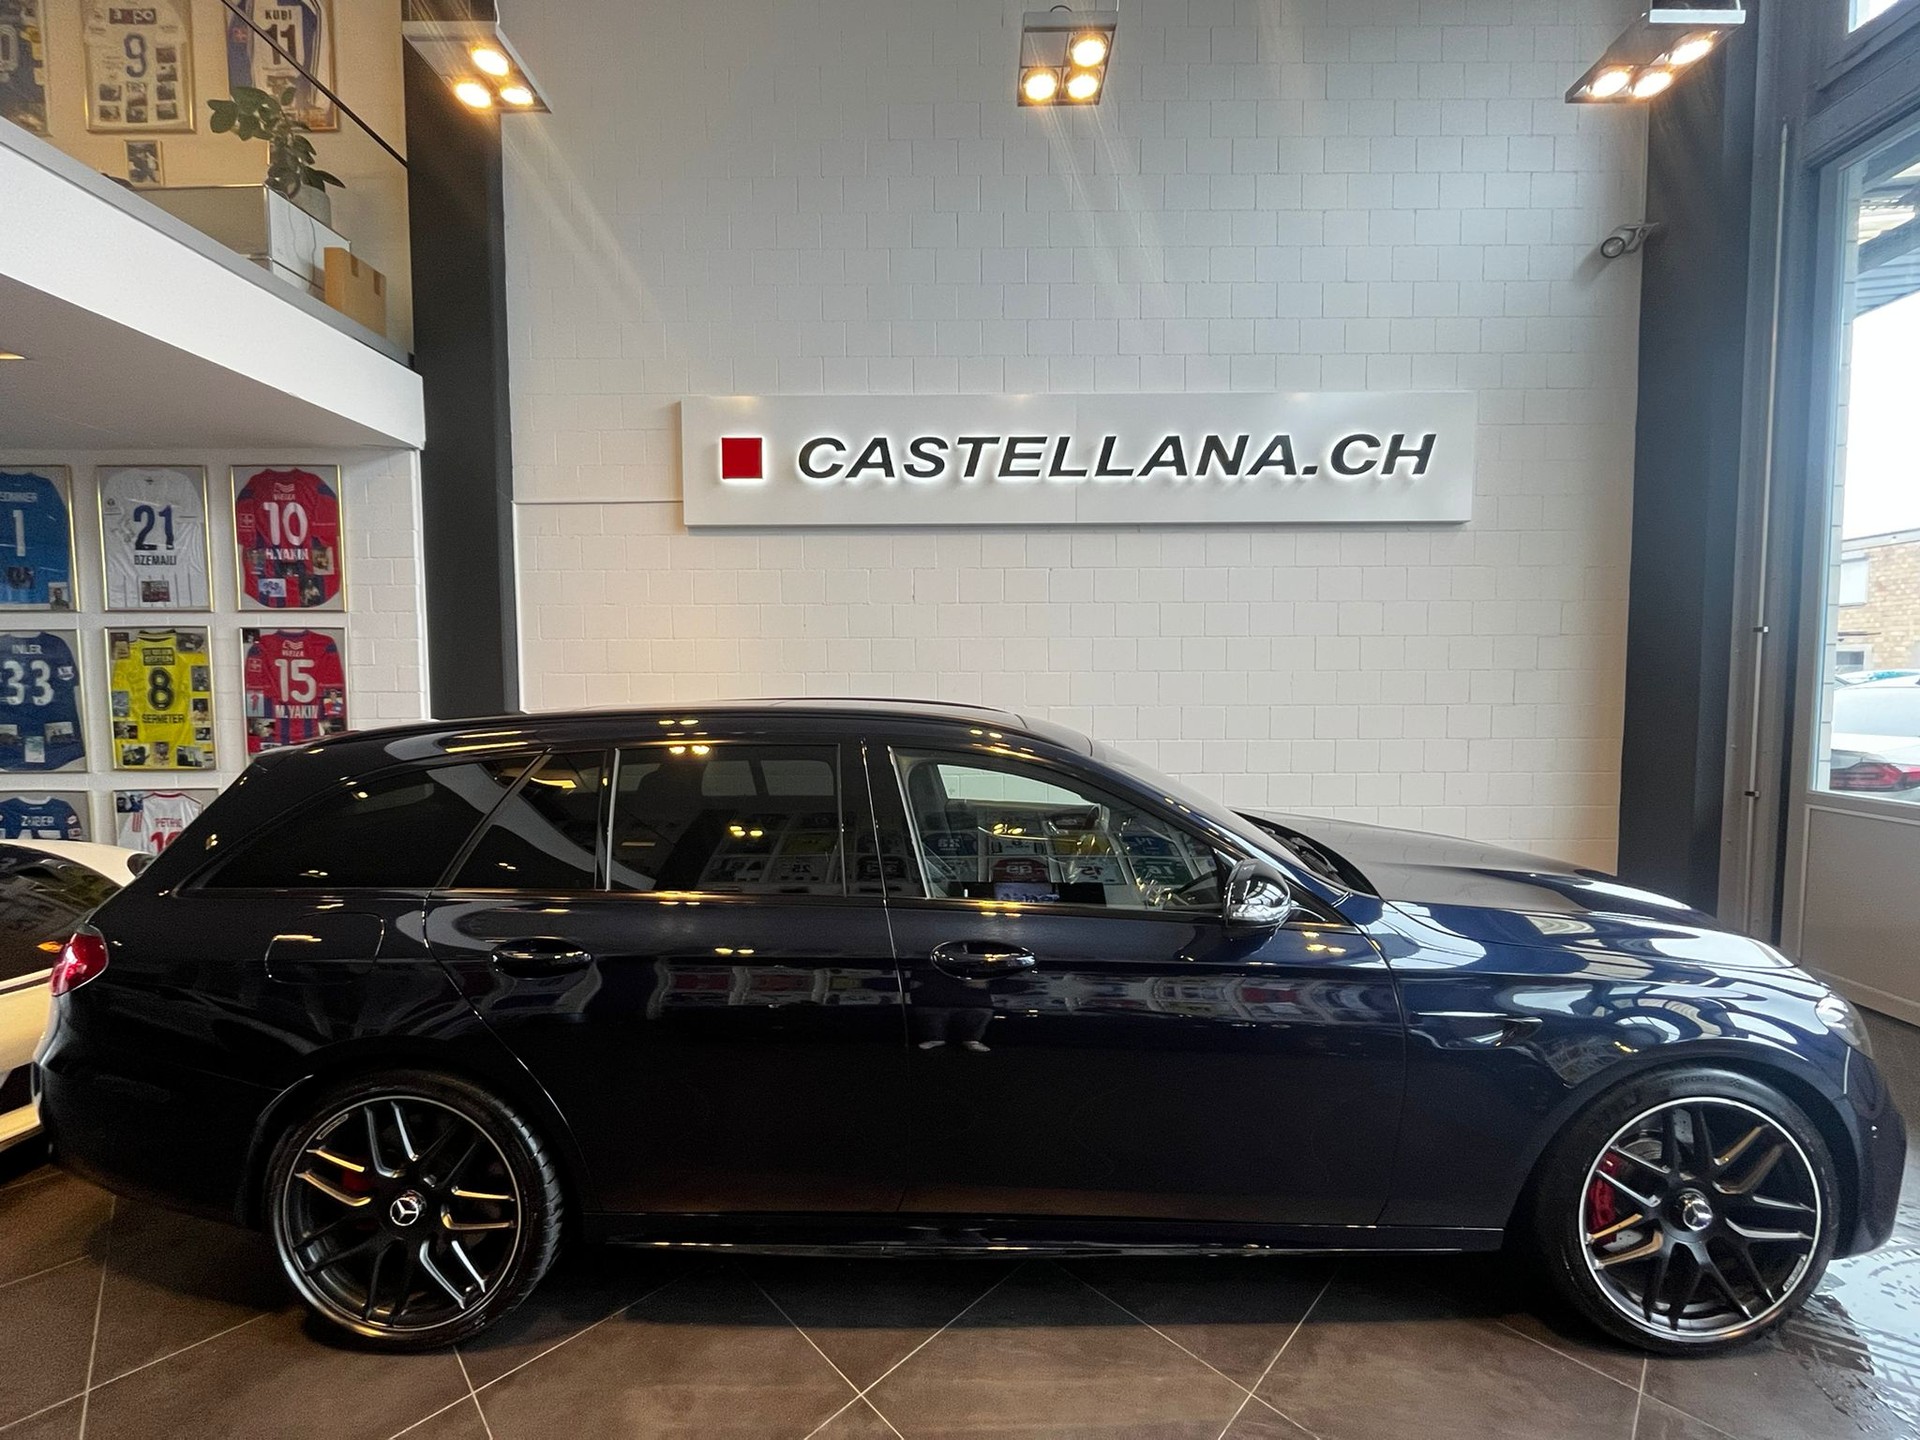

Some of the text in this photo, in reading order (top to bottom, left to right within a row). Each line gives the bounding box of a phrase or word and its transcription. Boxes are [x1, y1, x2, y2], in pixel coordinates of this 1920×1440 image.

[265, 9, 292, 20] KUBI
[124, 32, 147, 78] 9
[264, 24, 296, 65] 11
[798, 433, 1437, 479] CASTELLANA.CH
[133, 504, 174, 550] 21
[263, 501, 309, 546] 10
[134, 554, 176, 566] DZEMAILI
[4, 660, 55, 706] 33
[148, 666, 175, 711] 8
[274, 658, 317, 703] 15
[275, 704, 319, 719] M.YAKIN
